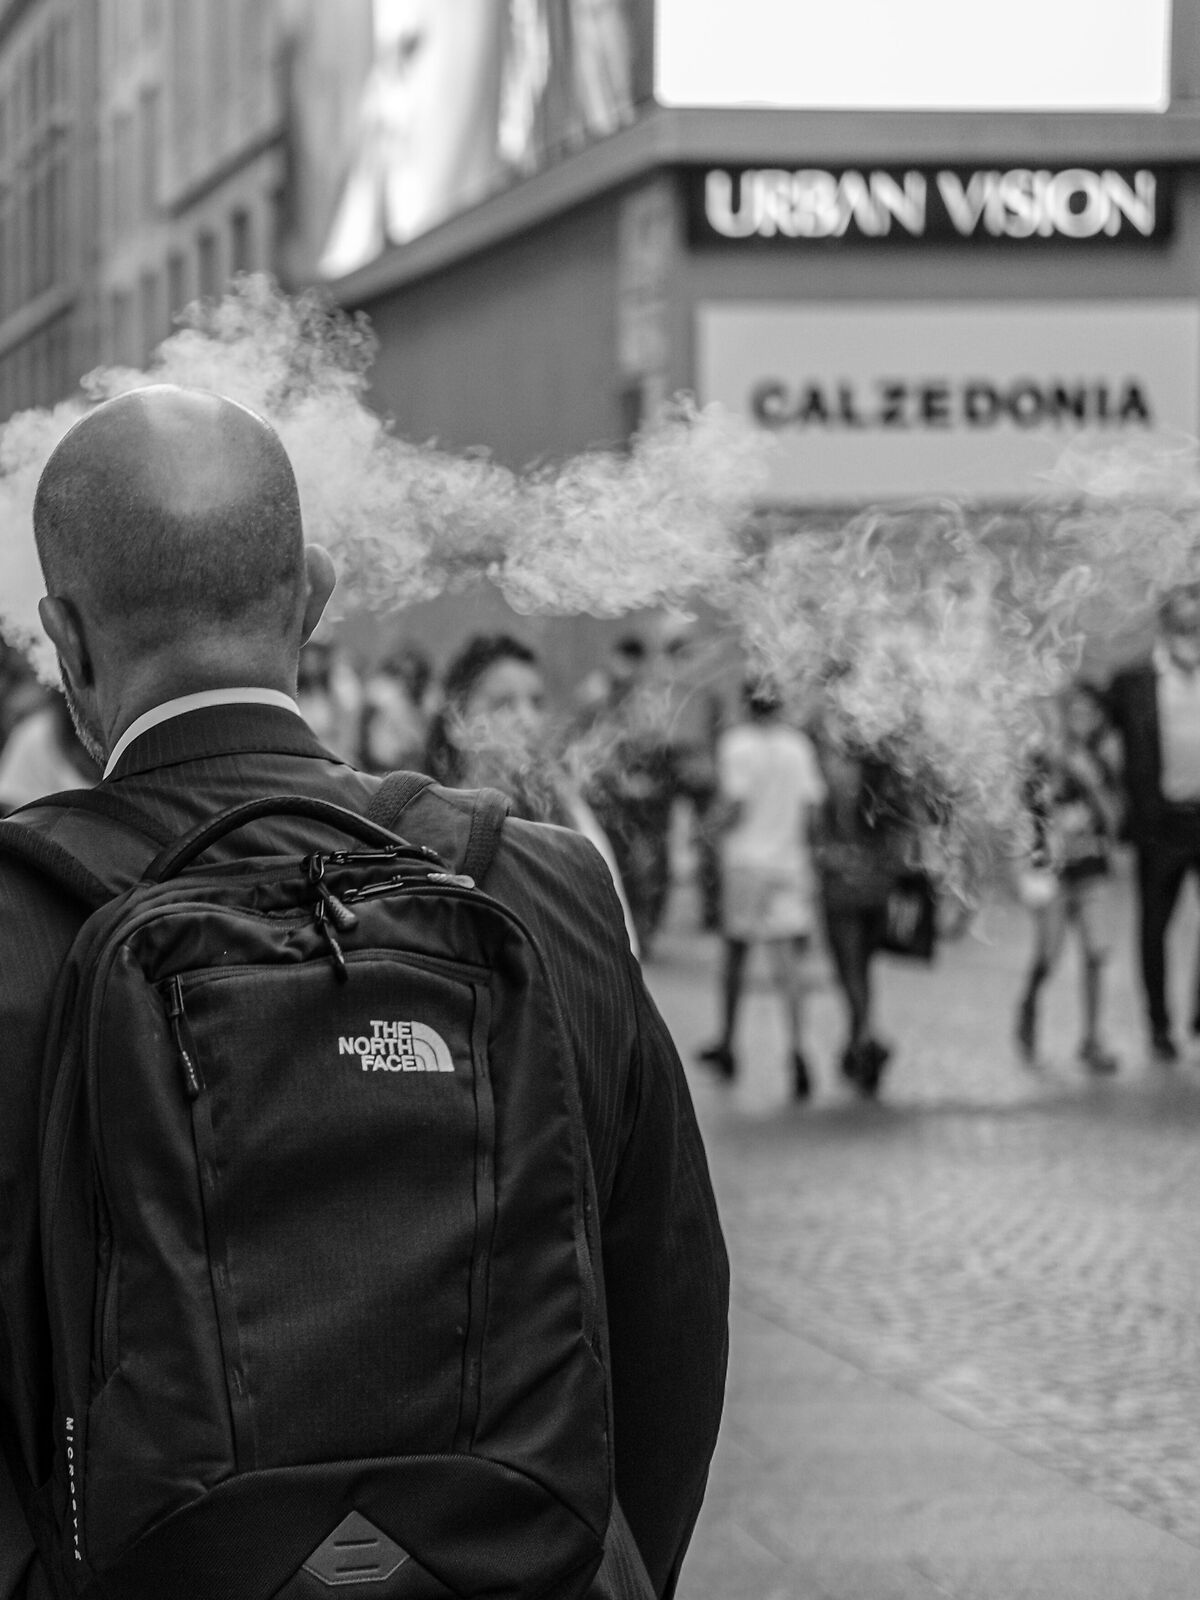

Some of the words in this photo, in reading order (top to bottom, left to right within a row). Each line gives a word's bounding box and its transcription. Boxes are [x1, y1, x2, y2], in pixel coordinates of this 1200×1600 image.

[704, 168, 927, 238] URBAN
[936, 168, 1157, 238] VISION
[750, 373, 1153, 431] CALZEDONIA
[369, 1020, 412, 1039] THE
[338, 1036, 413, 1055] NORTH
[361, 1054, 417, 1072] FACE
